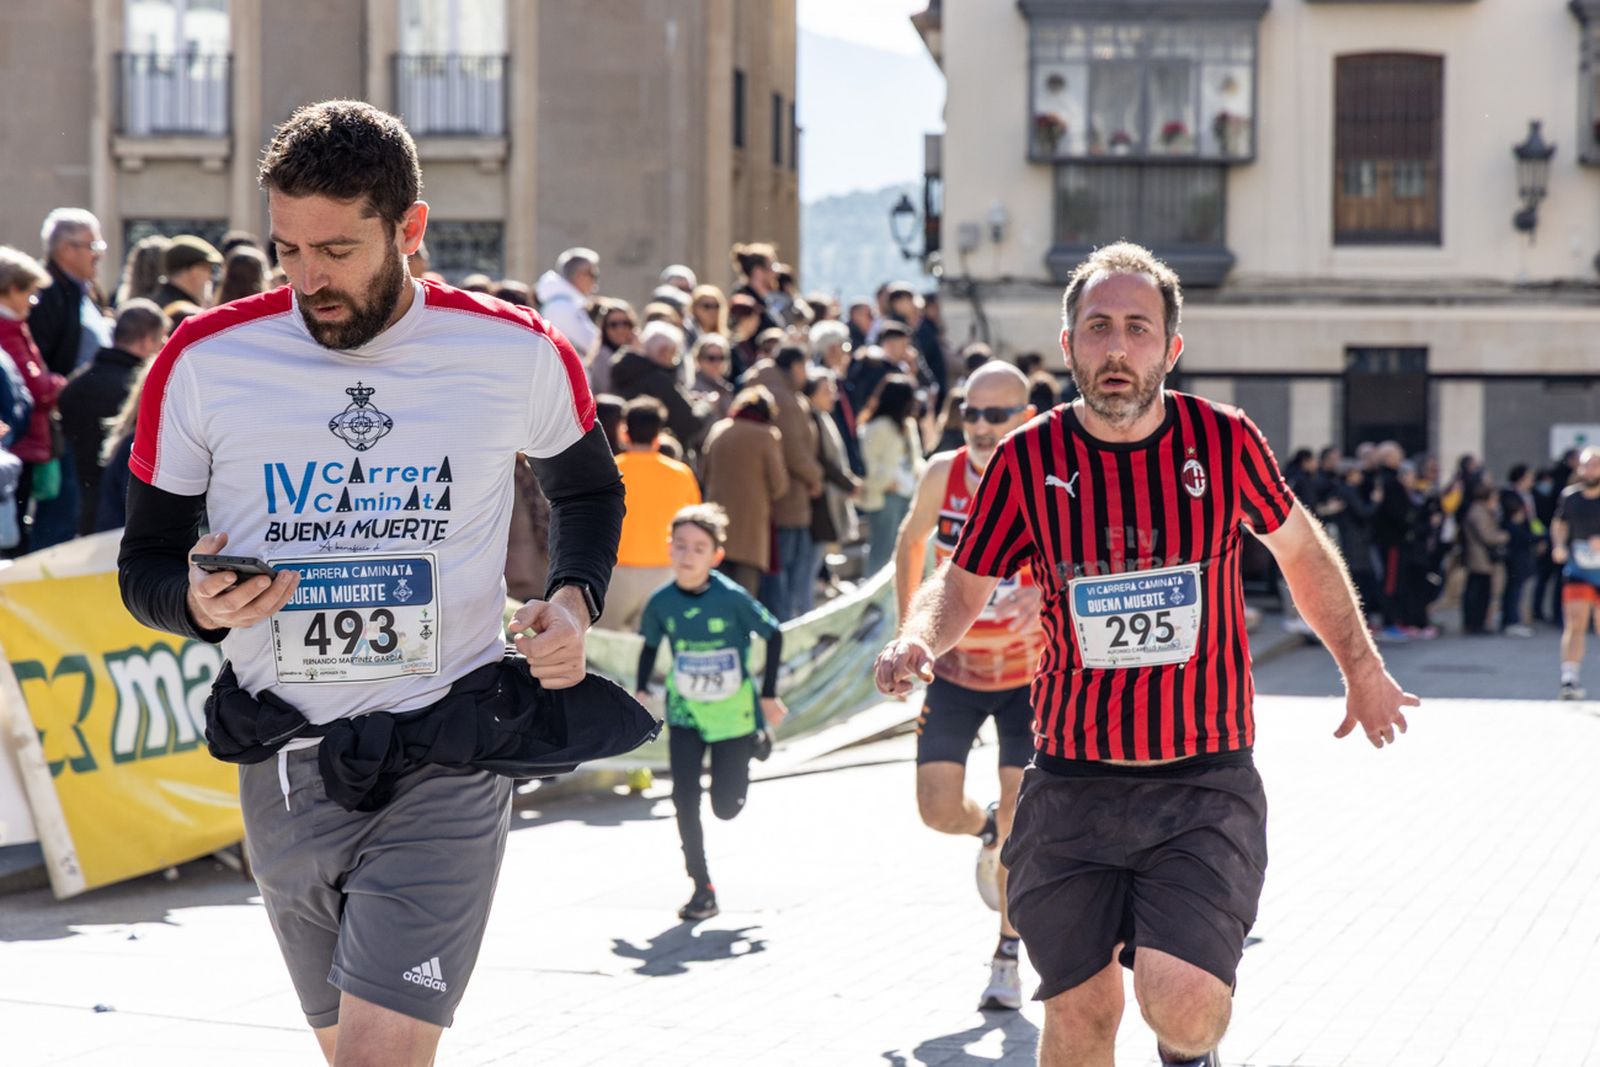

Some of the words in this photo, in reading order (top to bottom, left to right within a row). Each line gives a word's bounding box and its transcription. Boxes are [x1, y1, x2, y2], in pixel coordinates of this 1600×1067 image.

[264, 461, 317, 514] IV
[264, 519, 346, 542] BUENA
[350, 518, 449, 544] MUERTE
[1105, 526, 1160, 553] Fly
[299, 567, 349, 580] CARRERA
[351, 564, 413, 578] CAMINATA
[331, 584, 386, 603] MUERTE
[1096, 581, 1137, 594] CARRERA
[1138, 576, 1184, 590] CAMINATA
[1087, 597, 1121, 613] BUENA
[1123, 592, 1166, 609] MUERTE
[304, 608, 399, 656] 493
[1105, 610, 1175, 648] 295
[302, 658, 338, 666] FERNANDO
[688, 672, 725, 691] 779
[402, 970, 448, 992] adidas
